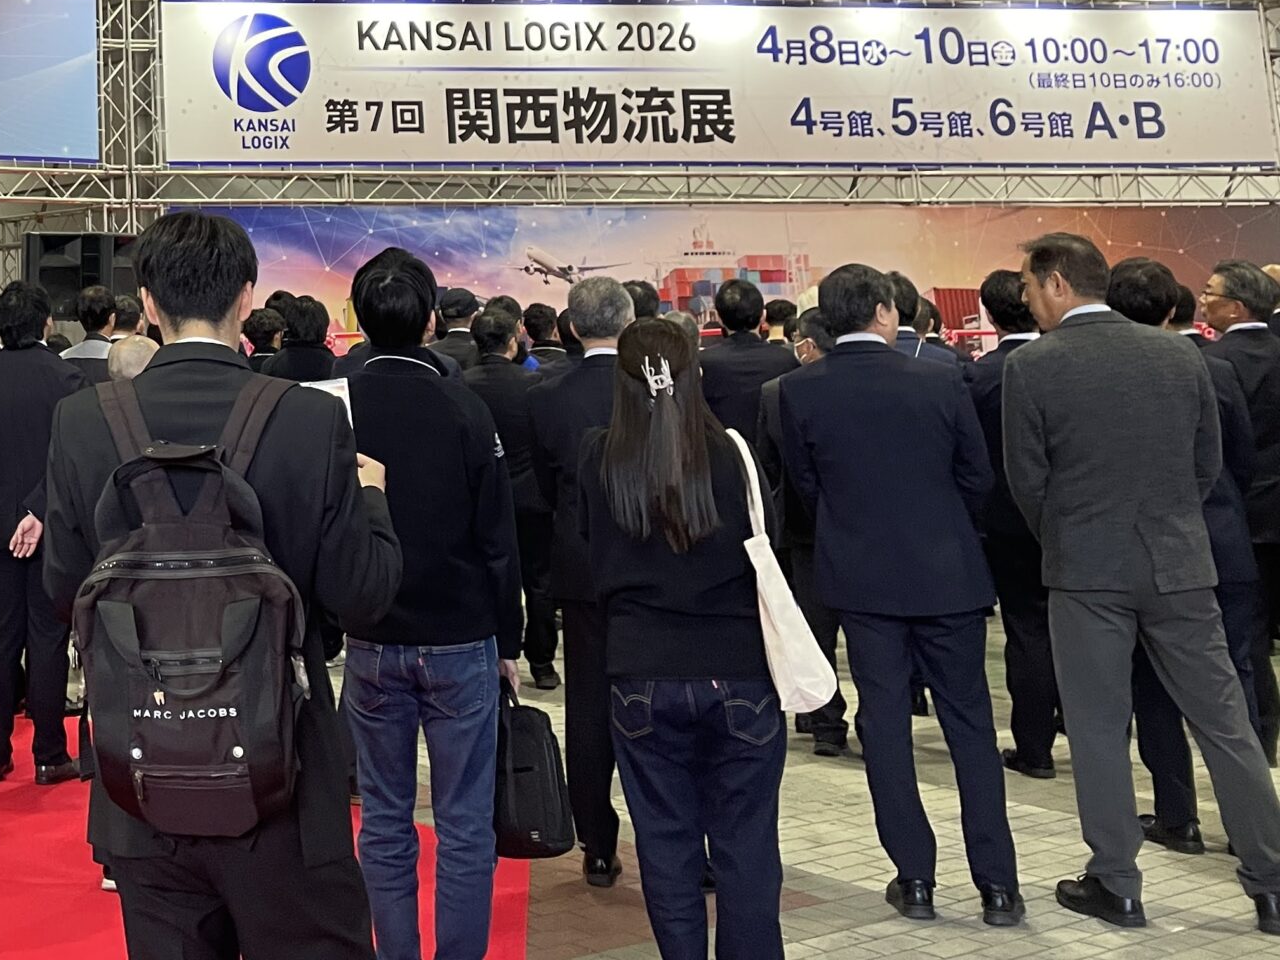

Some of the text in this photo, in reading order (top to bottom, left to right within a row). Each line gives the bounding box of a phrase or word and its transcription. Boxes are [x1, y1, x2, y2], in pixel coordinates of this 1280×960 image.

[357, 20, 696, 53] KANSAI LOGIX 2026
[324, 87, 736, 145] 第7回 関西物流展
[233, 117, 296, 133] KANSAI
[242, 136, 291, 150] LOGIX
[133, 708, 237, 720] MARC JACOBS
